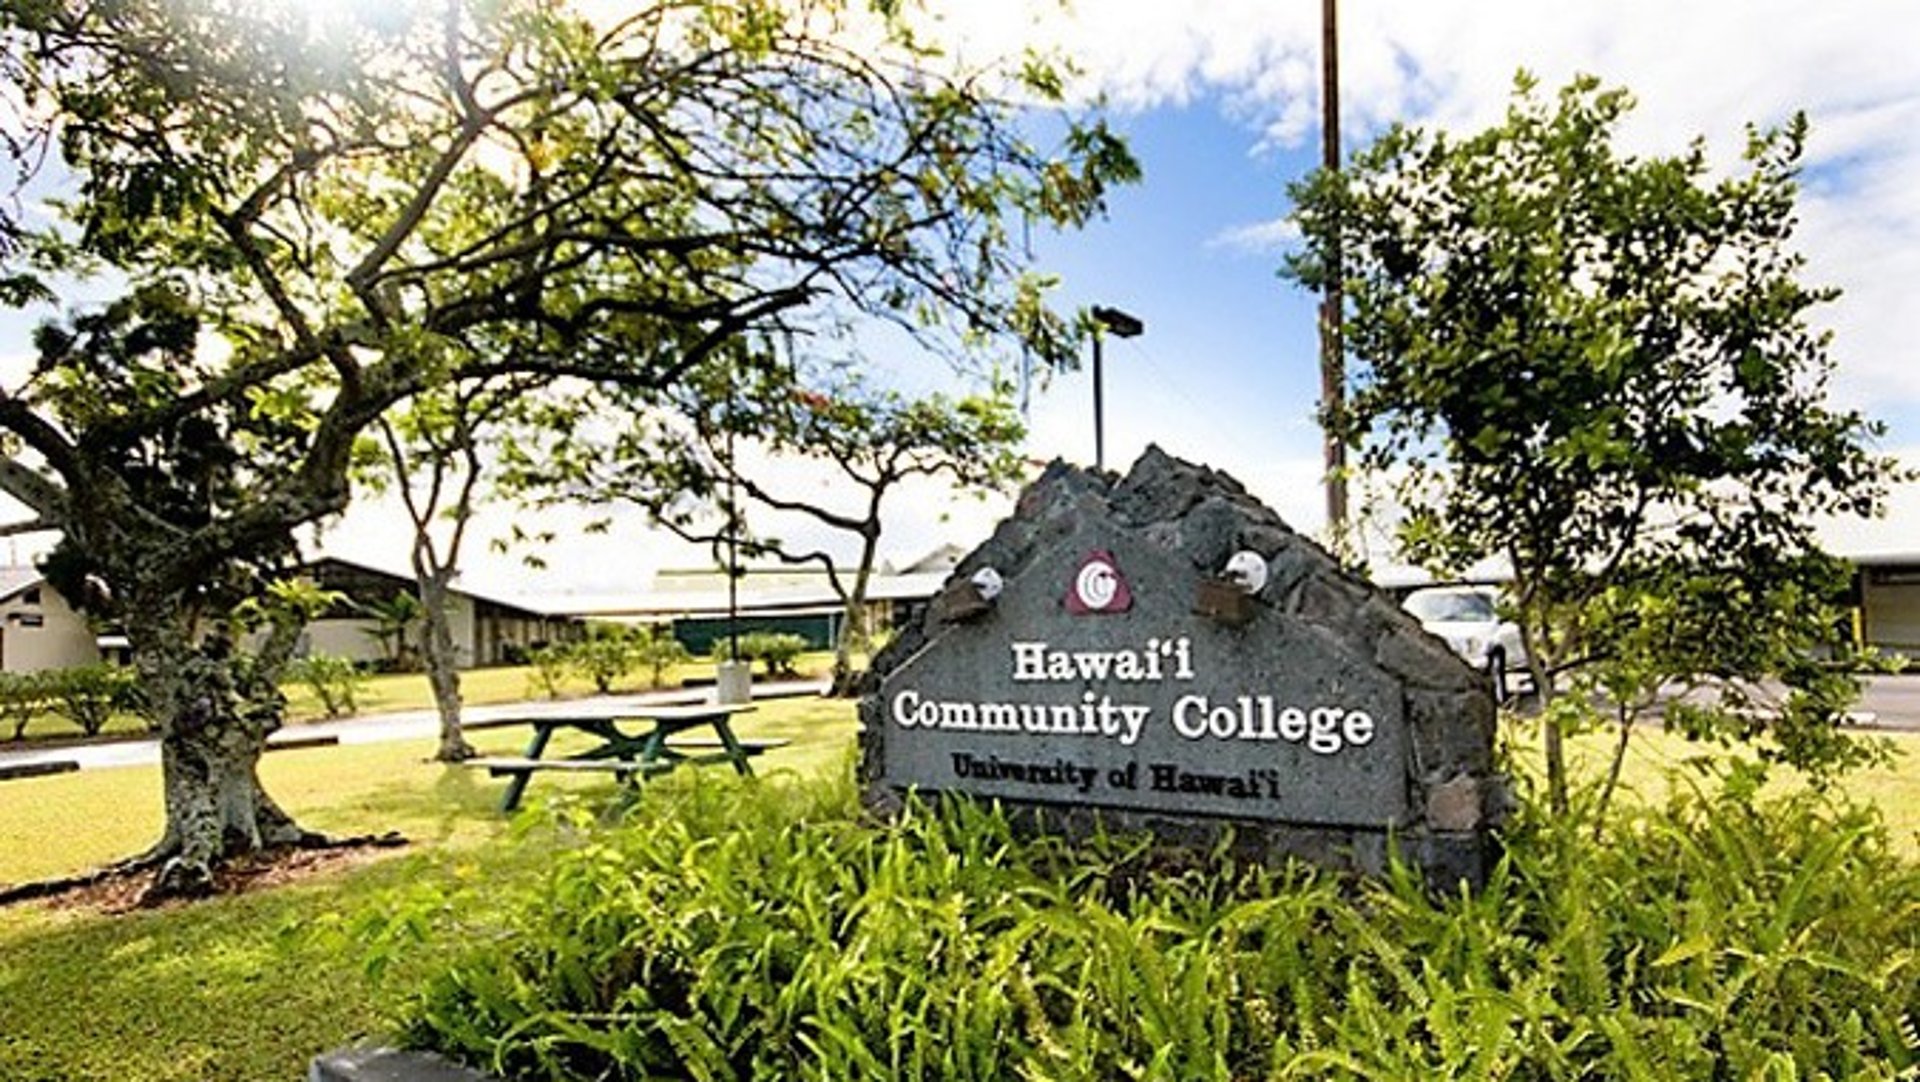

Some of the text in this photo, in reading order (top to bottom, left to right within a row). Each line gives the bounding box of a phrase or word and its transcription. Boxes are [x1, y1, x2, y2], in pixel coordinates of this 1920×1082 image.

[892, 689, 1374, 753] Community College
[951, 752, 1098, 793] University
[1107, 761, 1138, 790] of
